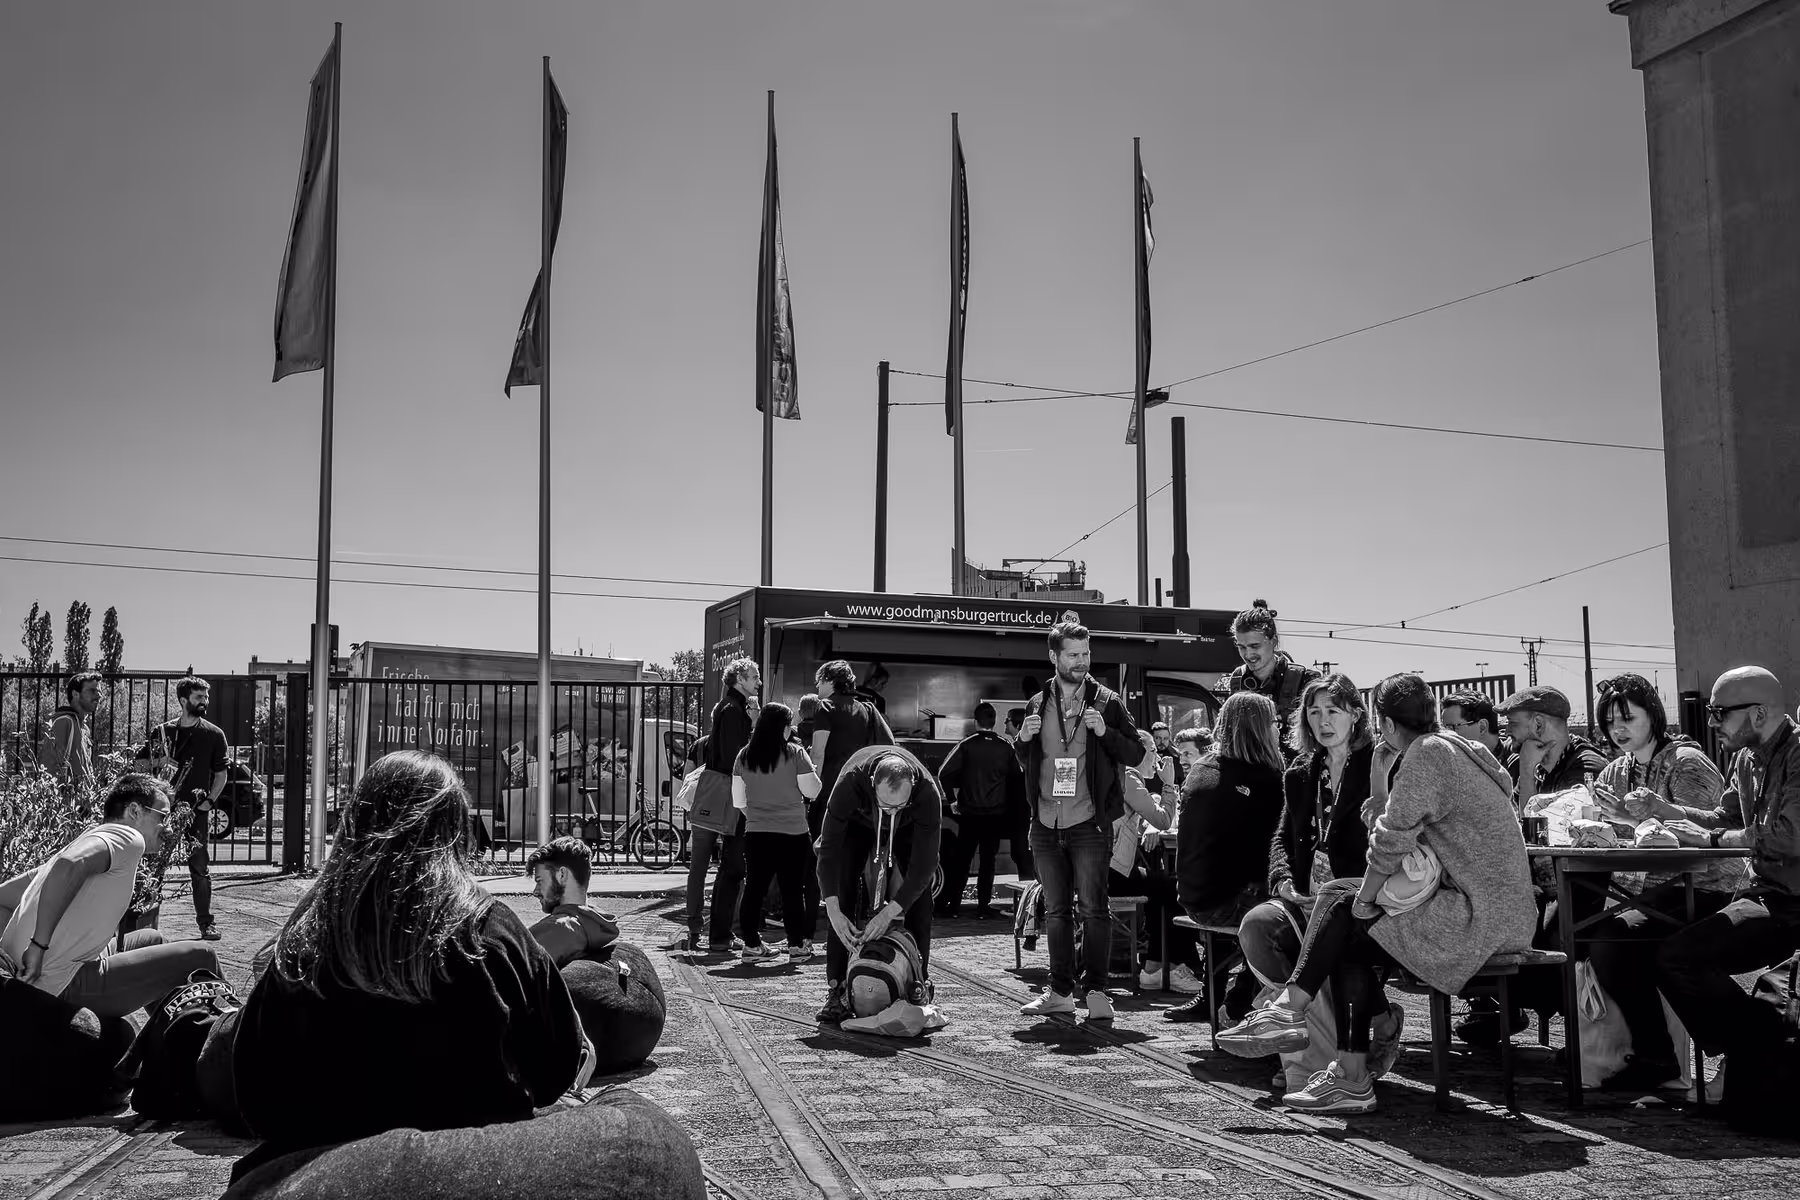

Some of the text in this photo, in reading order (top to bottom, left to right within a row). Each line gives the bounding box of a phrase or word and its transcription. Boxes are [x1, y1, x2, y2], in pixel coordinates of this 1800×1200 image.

[846, 604, 1052, 625] www.goodmansburgertruck.de
[395, 693, 480, 720] hat für mich
[595, 694, 607, 703] DIN
